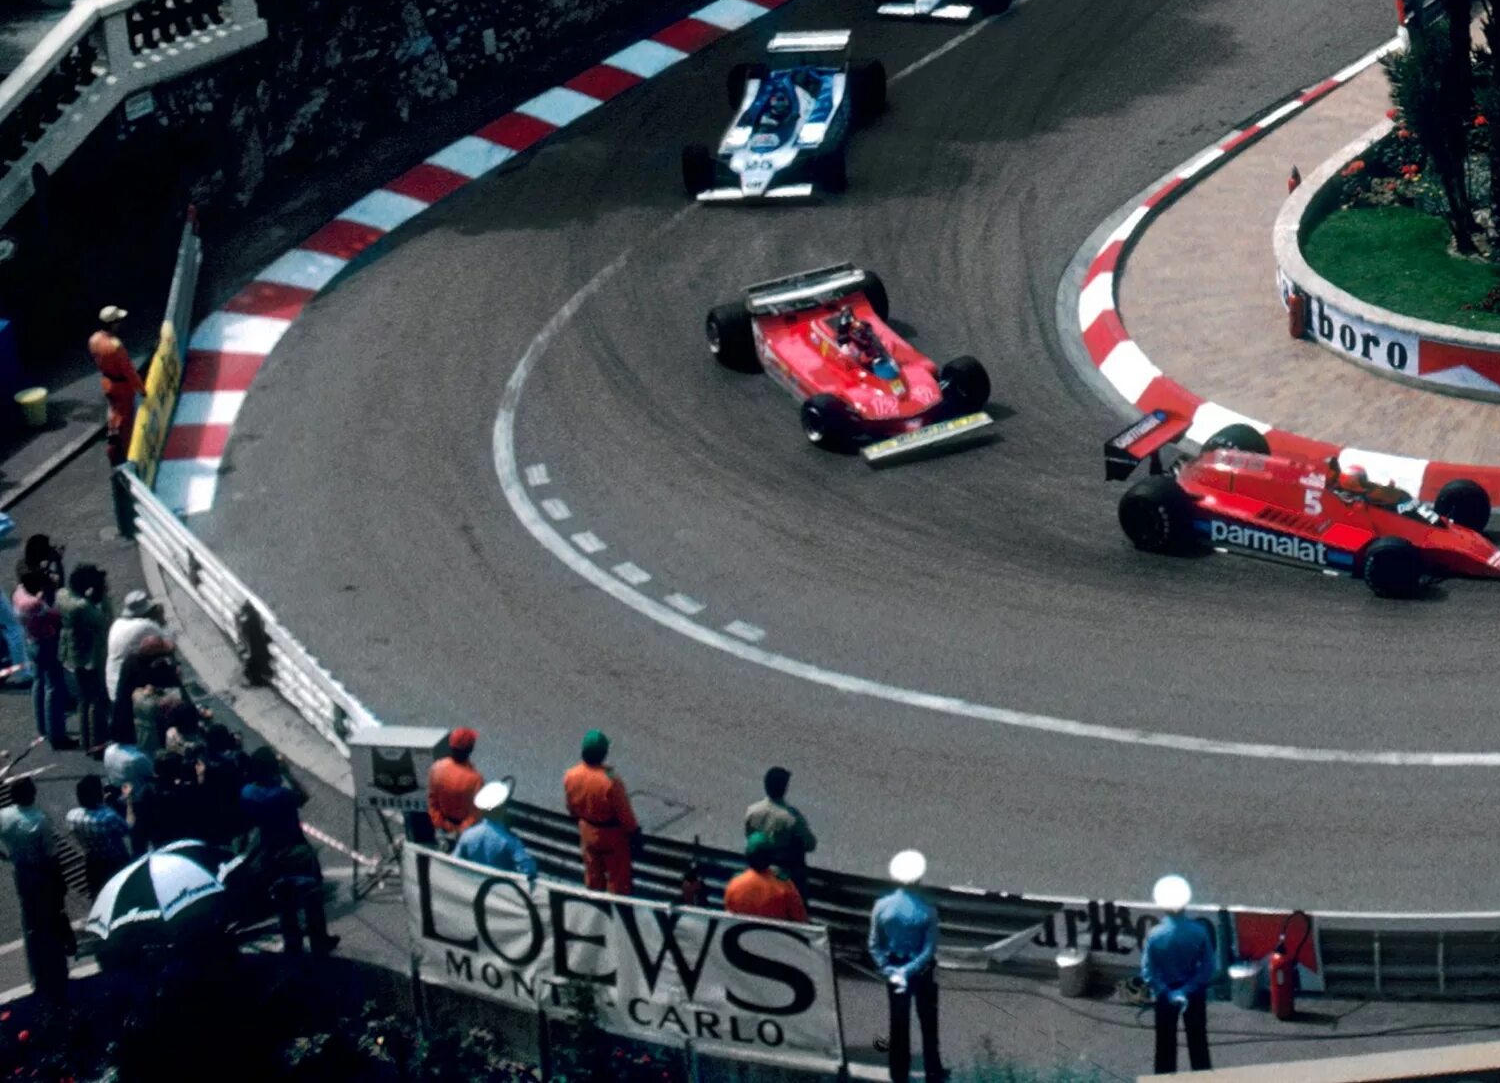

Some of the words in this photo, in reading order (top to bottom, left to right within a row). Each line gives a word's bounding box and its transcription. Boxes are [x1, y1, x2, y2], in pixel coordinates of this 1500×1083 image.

[1304, 488, 1324, 516] 5
[1211, 519, 1327, 566] parmalat
[417, 854, 816, 1016] LOEWS
